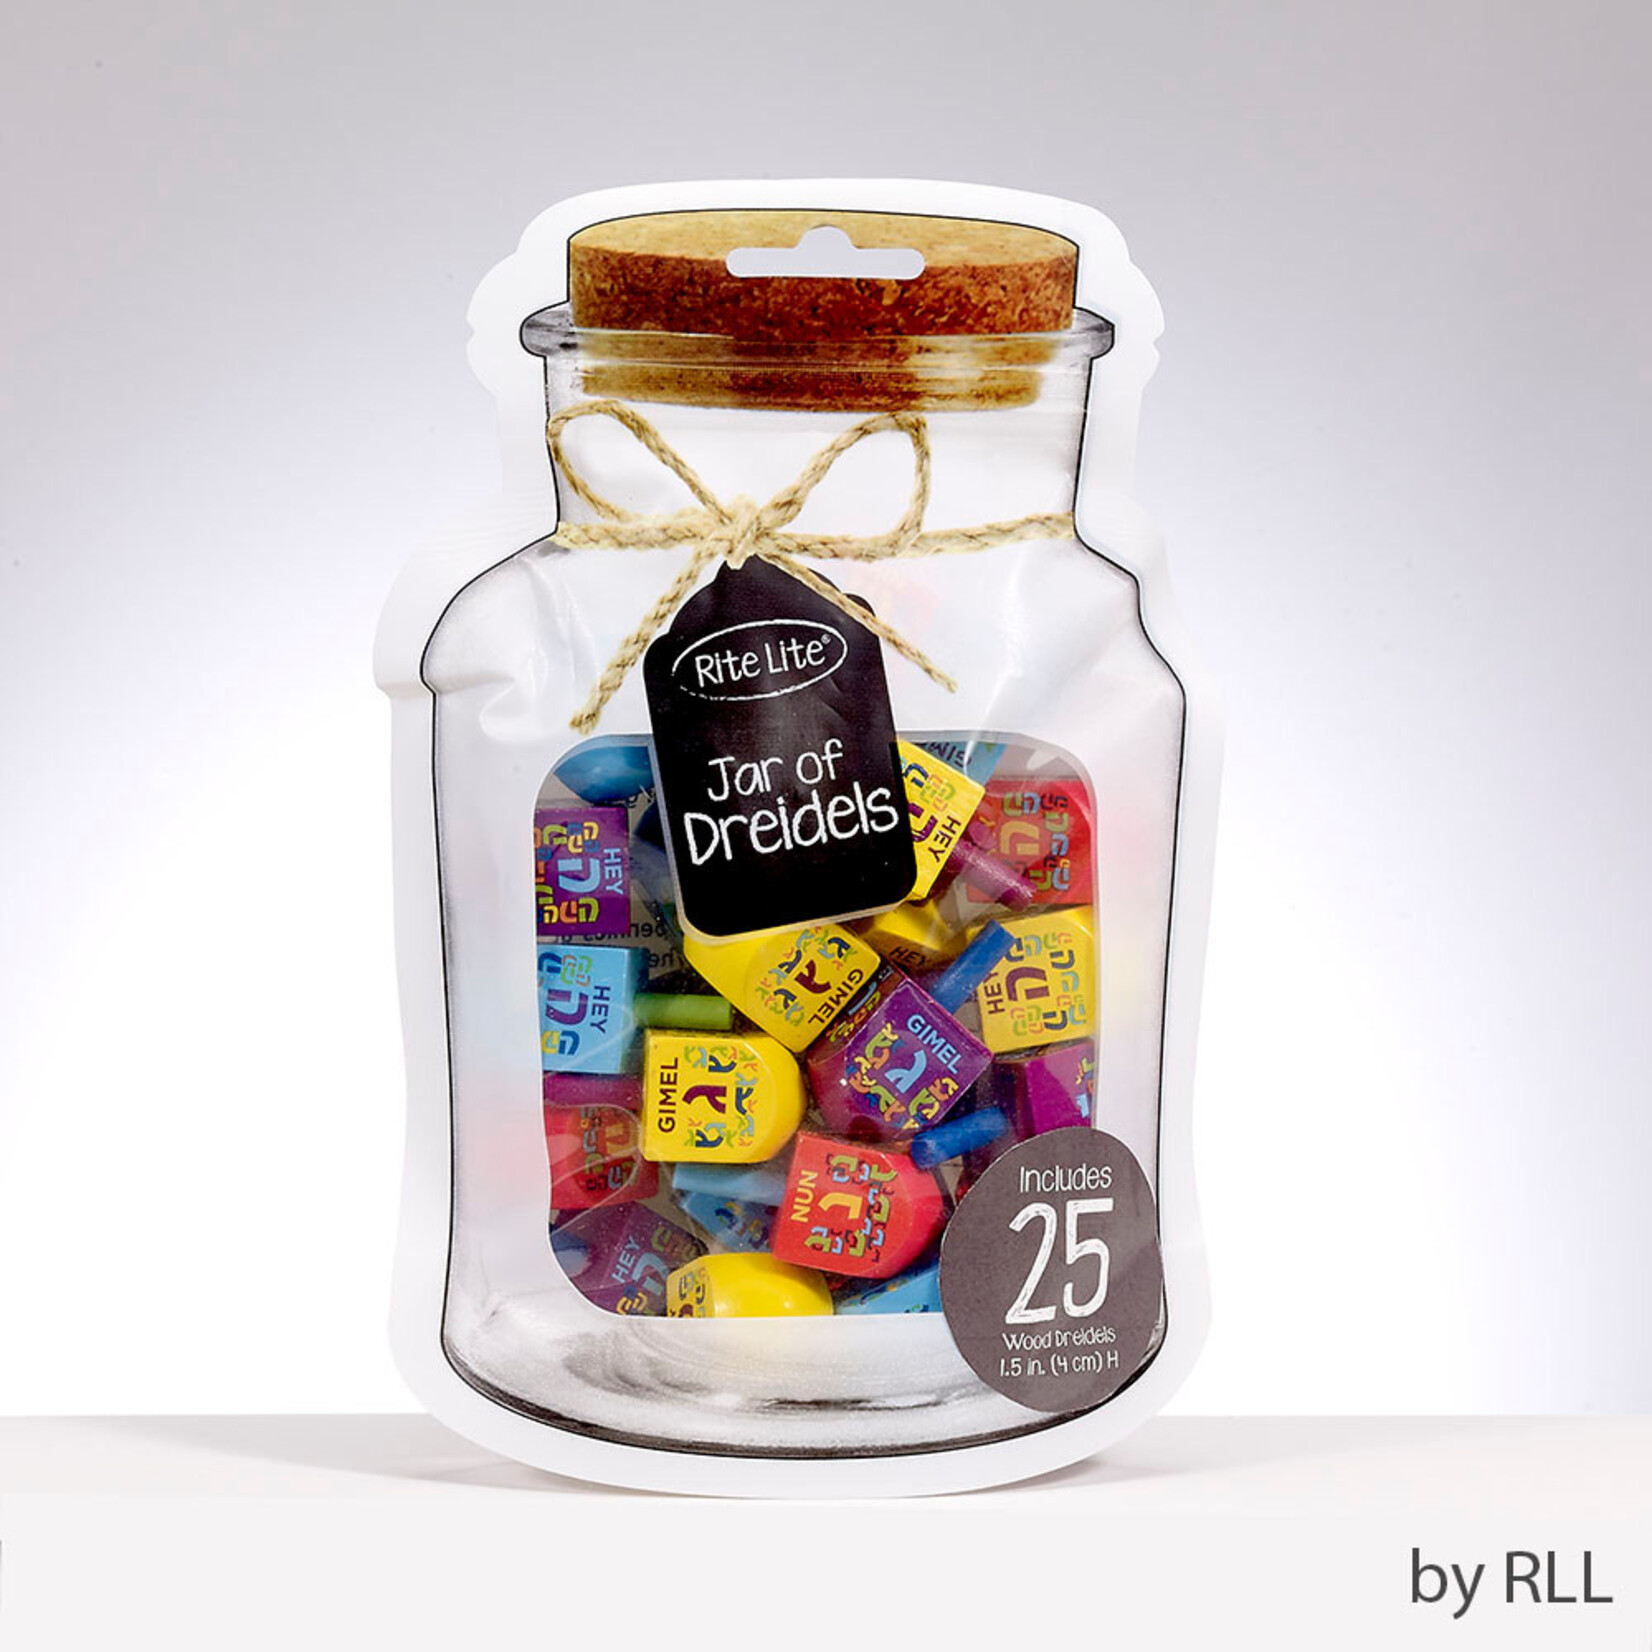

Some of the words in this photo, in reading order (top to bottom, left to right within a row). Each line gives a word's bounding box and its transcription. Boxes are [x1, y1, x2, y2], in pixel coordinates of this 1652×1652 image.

[694, 649, 761, 688] Rite
[707, 755, 783, 801] Jar
[795, 738, 844, 784] of
[683, 781, 899, 866] Dreidels
[928, 815, 962, 863] HEY
[603, 847, 624, 895] HEY
[590, 985, 611, 1034] HEY
[808, 968, 864, 1026] GIMEL
[906, 1013, 964, 1075] GIMEL
[657, 1057, 679, 1133] GIMEL
[790, 1170, 818, 1223] NUN
[1020, 1163, 1113, 1193] Includes
[611, 1235, 640, 1284] HEY
[1004, 1197, 1115, 1325] 25
[1000, 1358, 1022, 1377] 1.5
[1027, 1357, 1047, 1376] in.
[1050, 1353, 1068, 1377] (4
[1072, 1351, 1103, 1373] cm)
[1107, 1350, 1119, 1369] H
[1002, 1330, 1052, 1351] Wood
